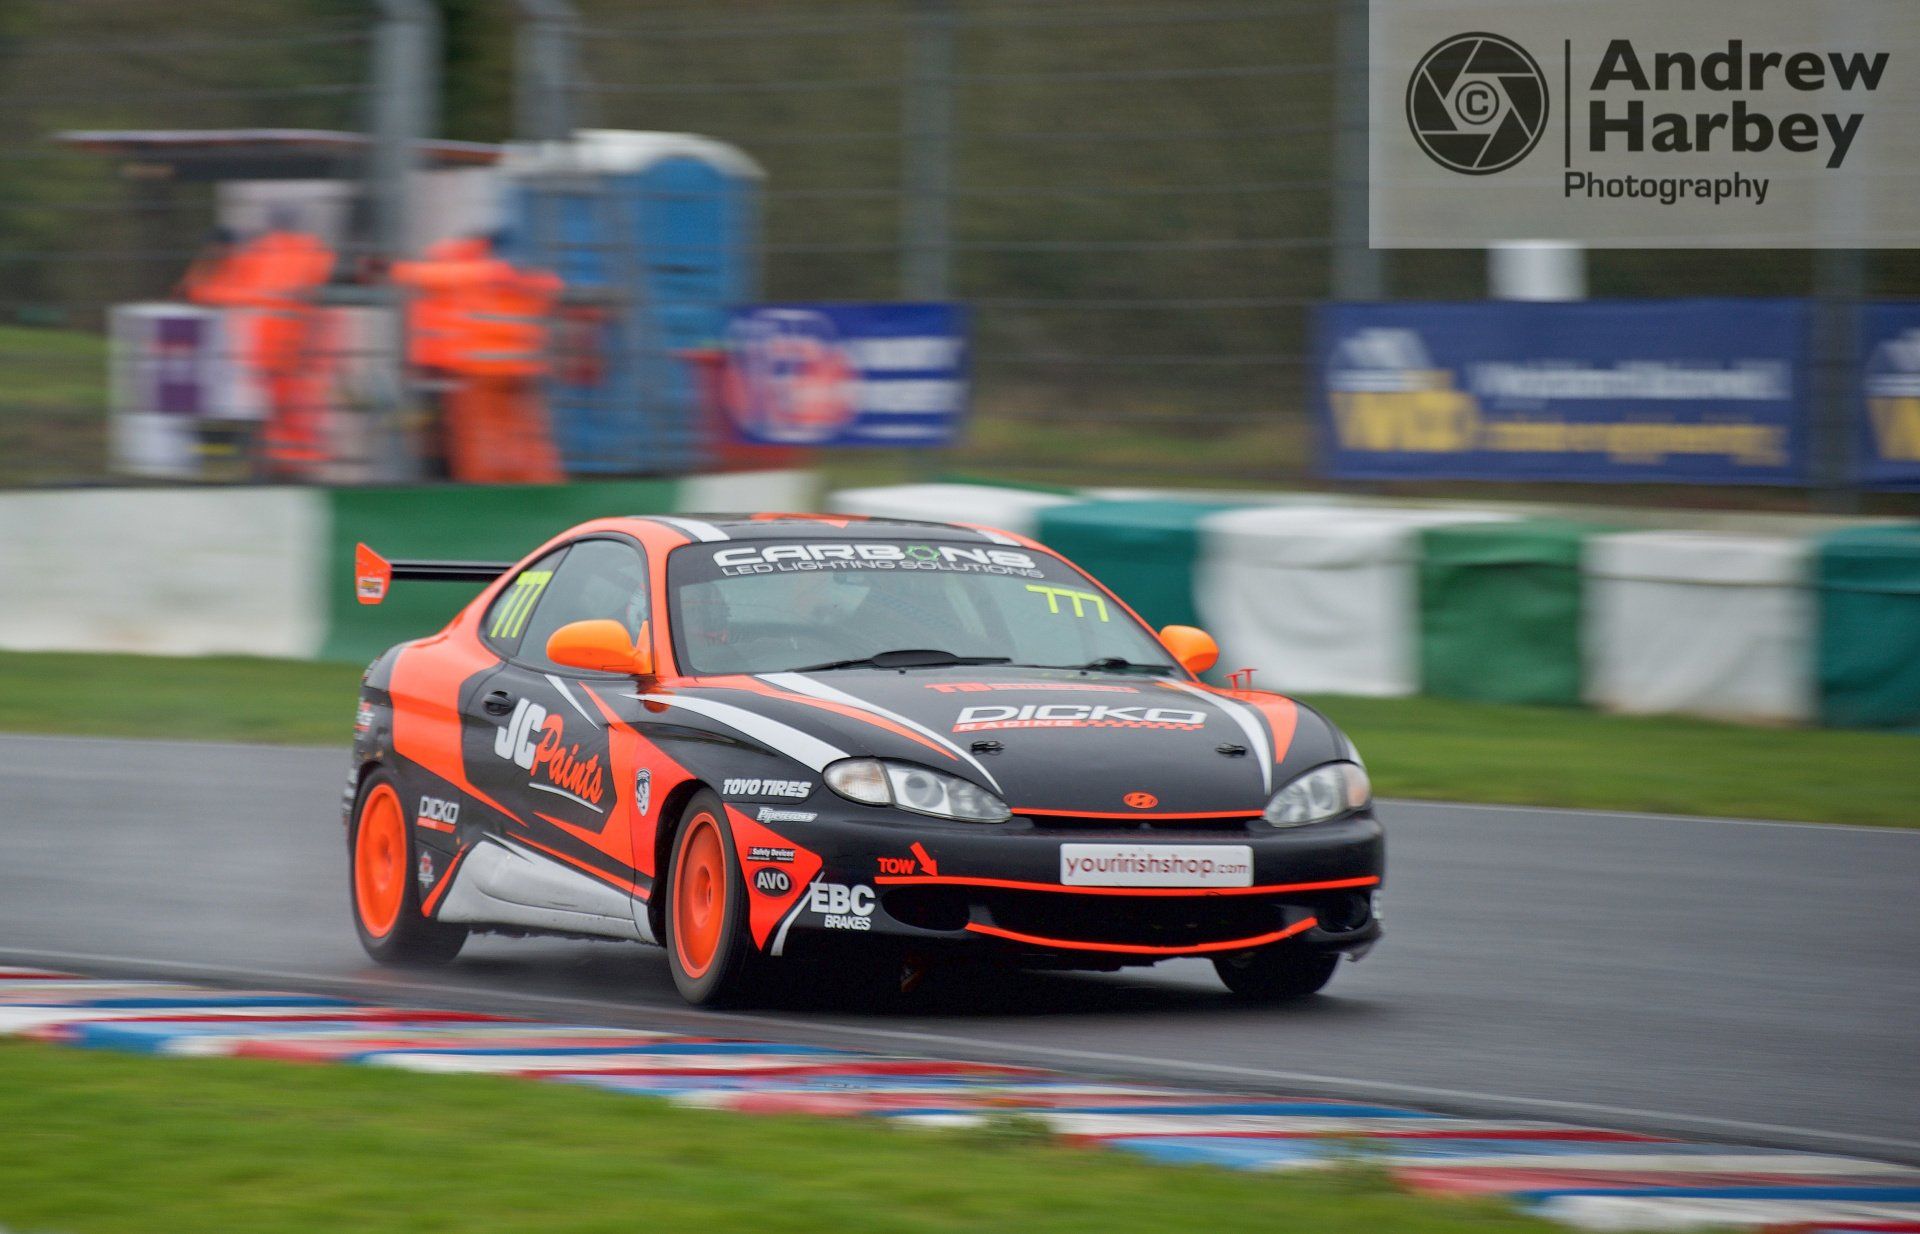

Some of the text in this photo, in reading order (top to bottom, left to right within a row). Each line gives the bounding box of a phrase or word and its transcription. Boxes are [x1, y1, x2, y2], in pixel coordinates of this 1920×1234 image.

[721, 559, 1045, 579] LED LIGHTING SOLUTIONS
[490, 570, 553, 638] 777
[1025, 584, 1109, 622] 777
[955, 704, 1208, 724] DICKO
[495, 698, 604, 804] JC Paints
[722, 779, 812, 798] TOYO TIRES
[752, 847, 771, 858] Safety
[877, 857, 916, 875] TOW
[1066, 853, 1249, 880] youririshshop.com
[756, 872, 789, 891] AVO
[809, 882, 877, 916] EBC
[824, 914, 872, 931] BRAKES
